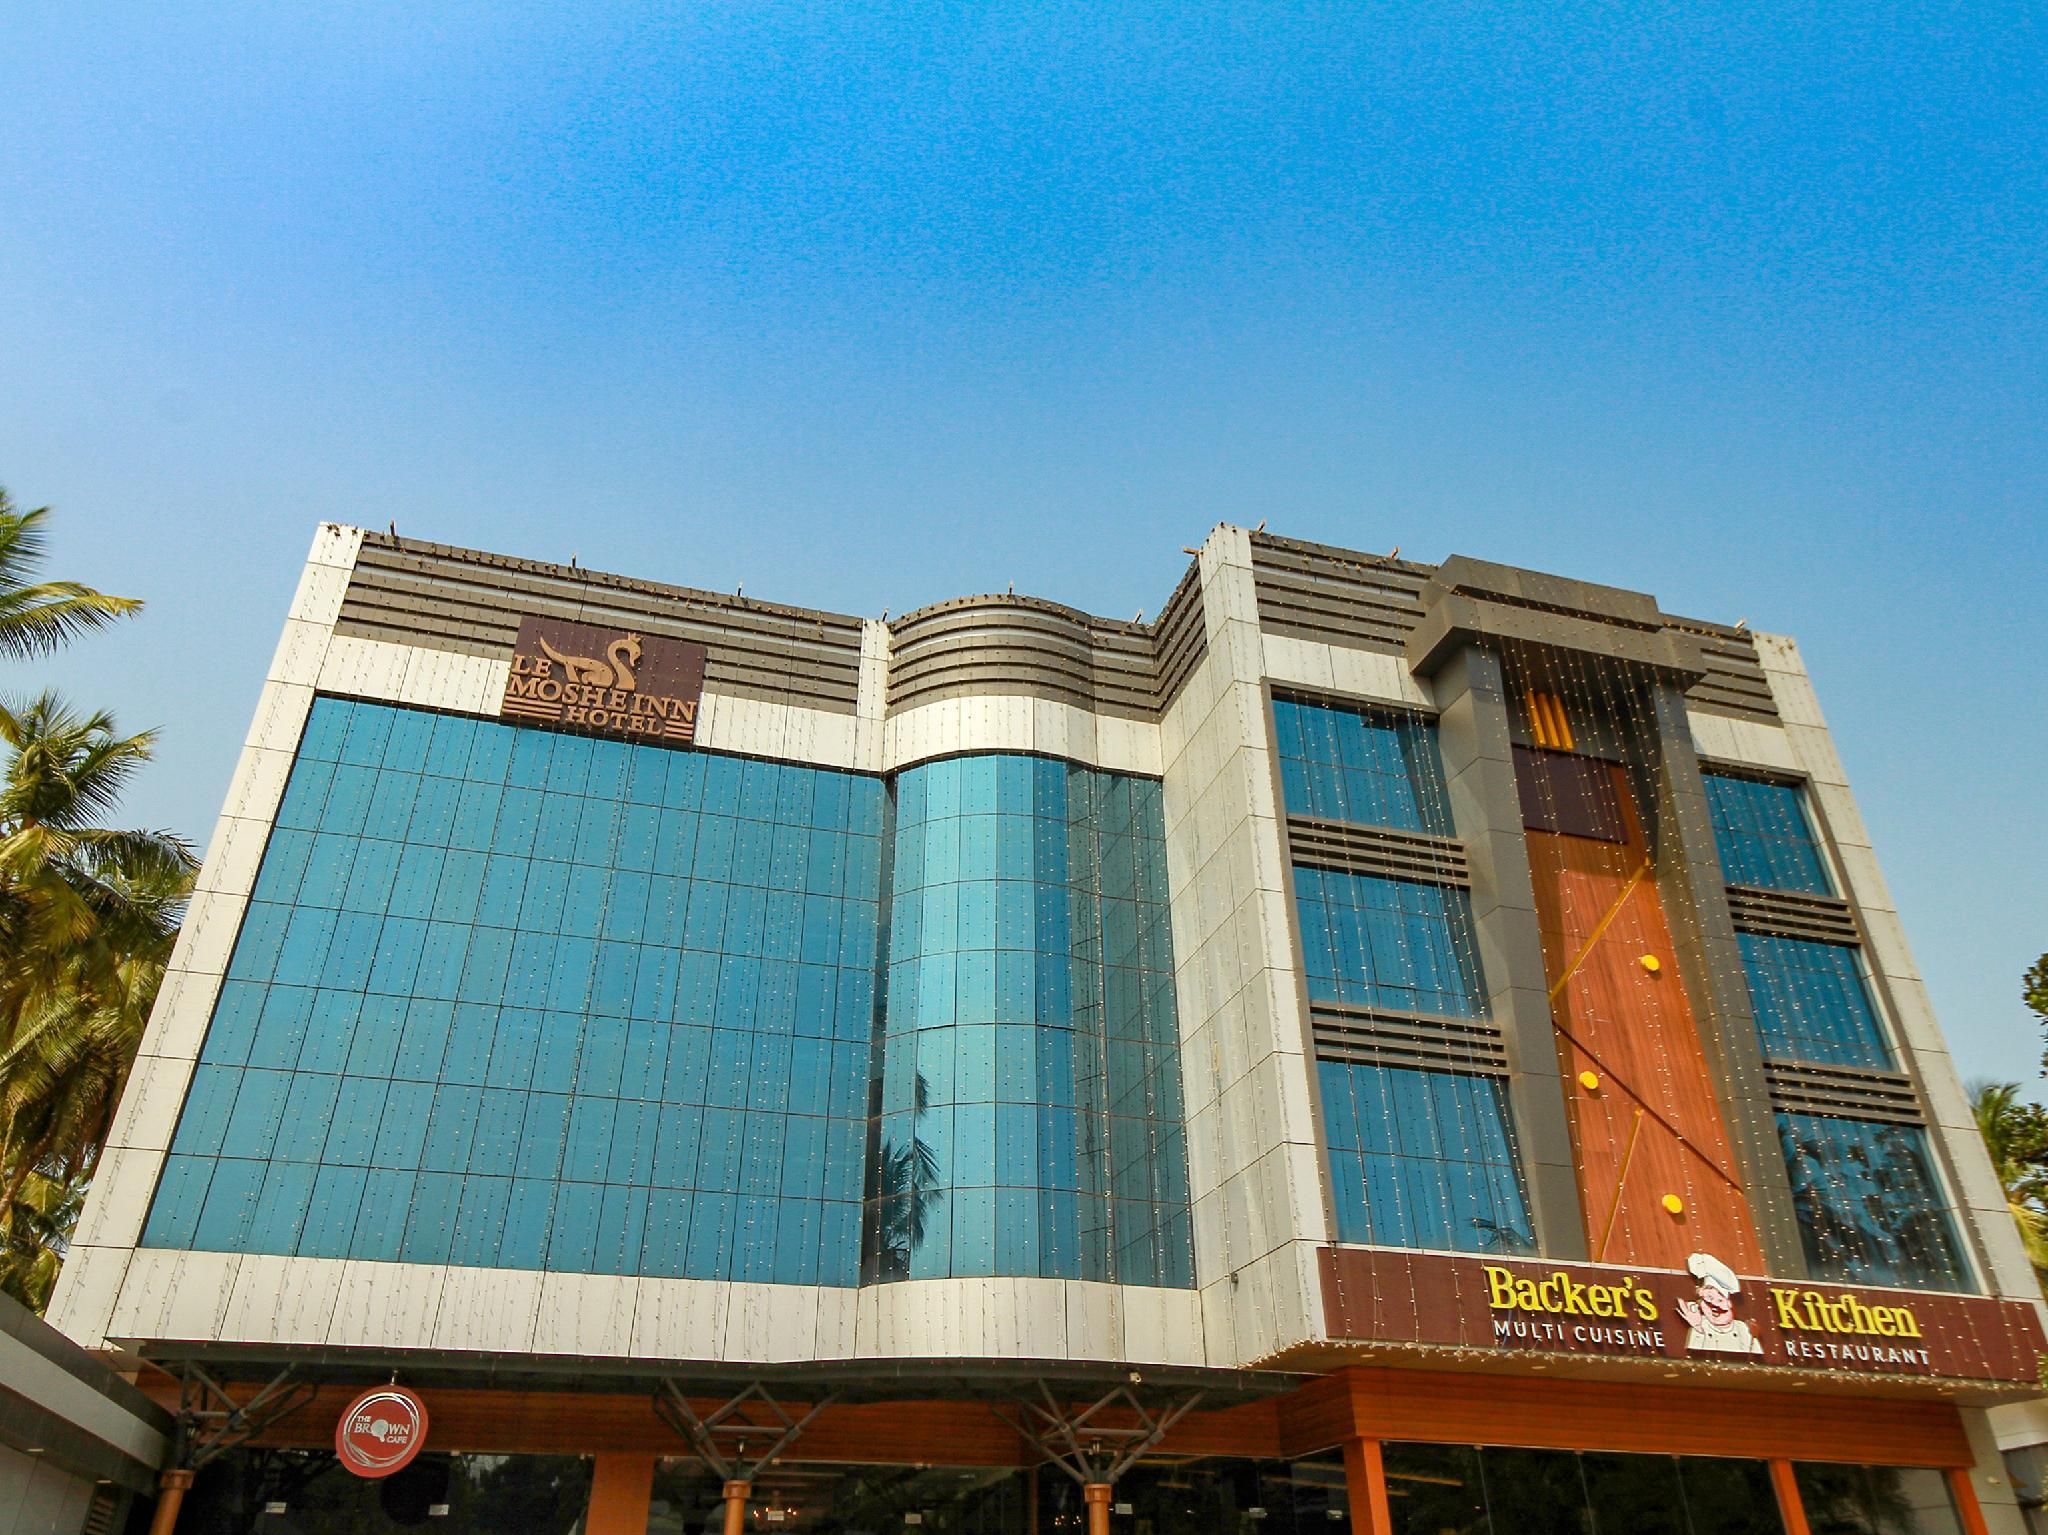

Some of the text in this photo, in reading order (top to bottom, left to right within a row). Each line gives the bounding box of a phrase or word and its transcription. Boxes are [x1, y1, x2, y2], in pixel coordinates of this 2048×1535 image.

[512, 654, 552, 678] LE
[565, 706, 663, 735] HOTEL
[1483, 1265, 1923, 1338] Backer's Kitchen
[1493, 1320, 1930, 1365] MULTI CUISINE RESTAURANT
[356, 1415, 372, 1423] THE
[386, 1435, 408, 1444] CAFE
